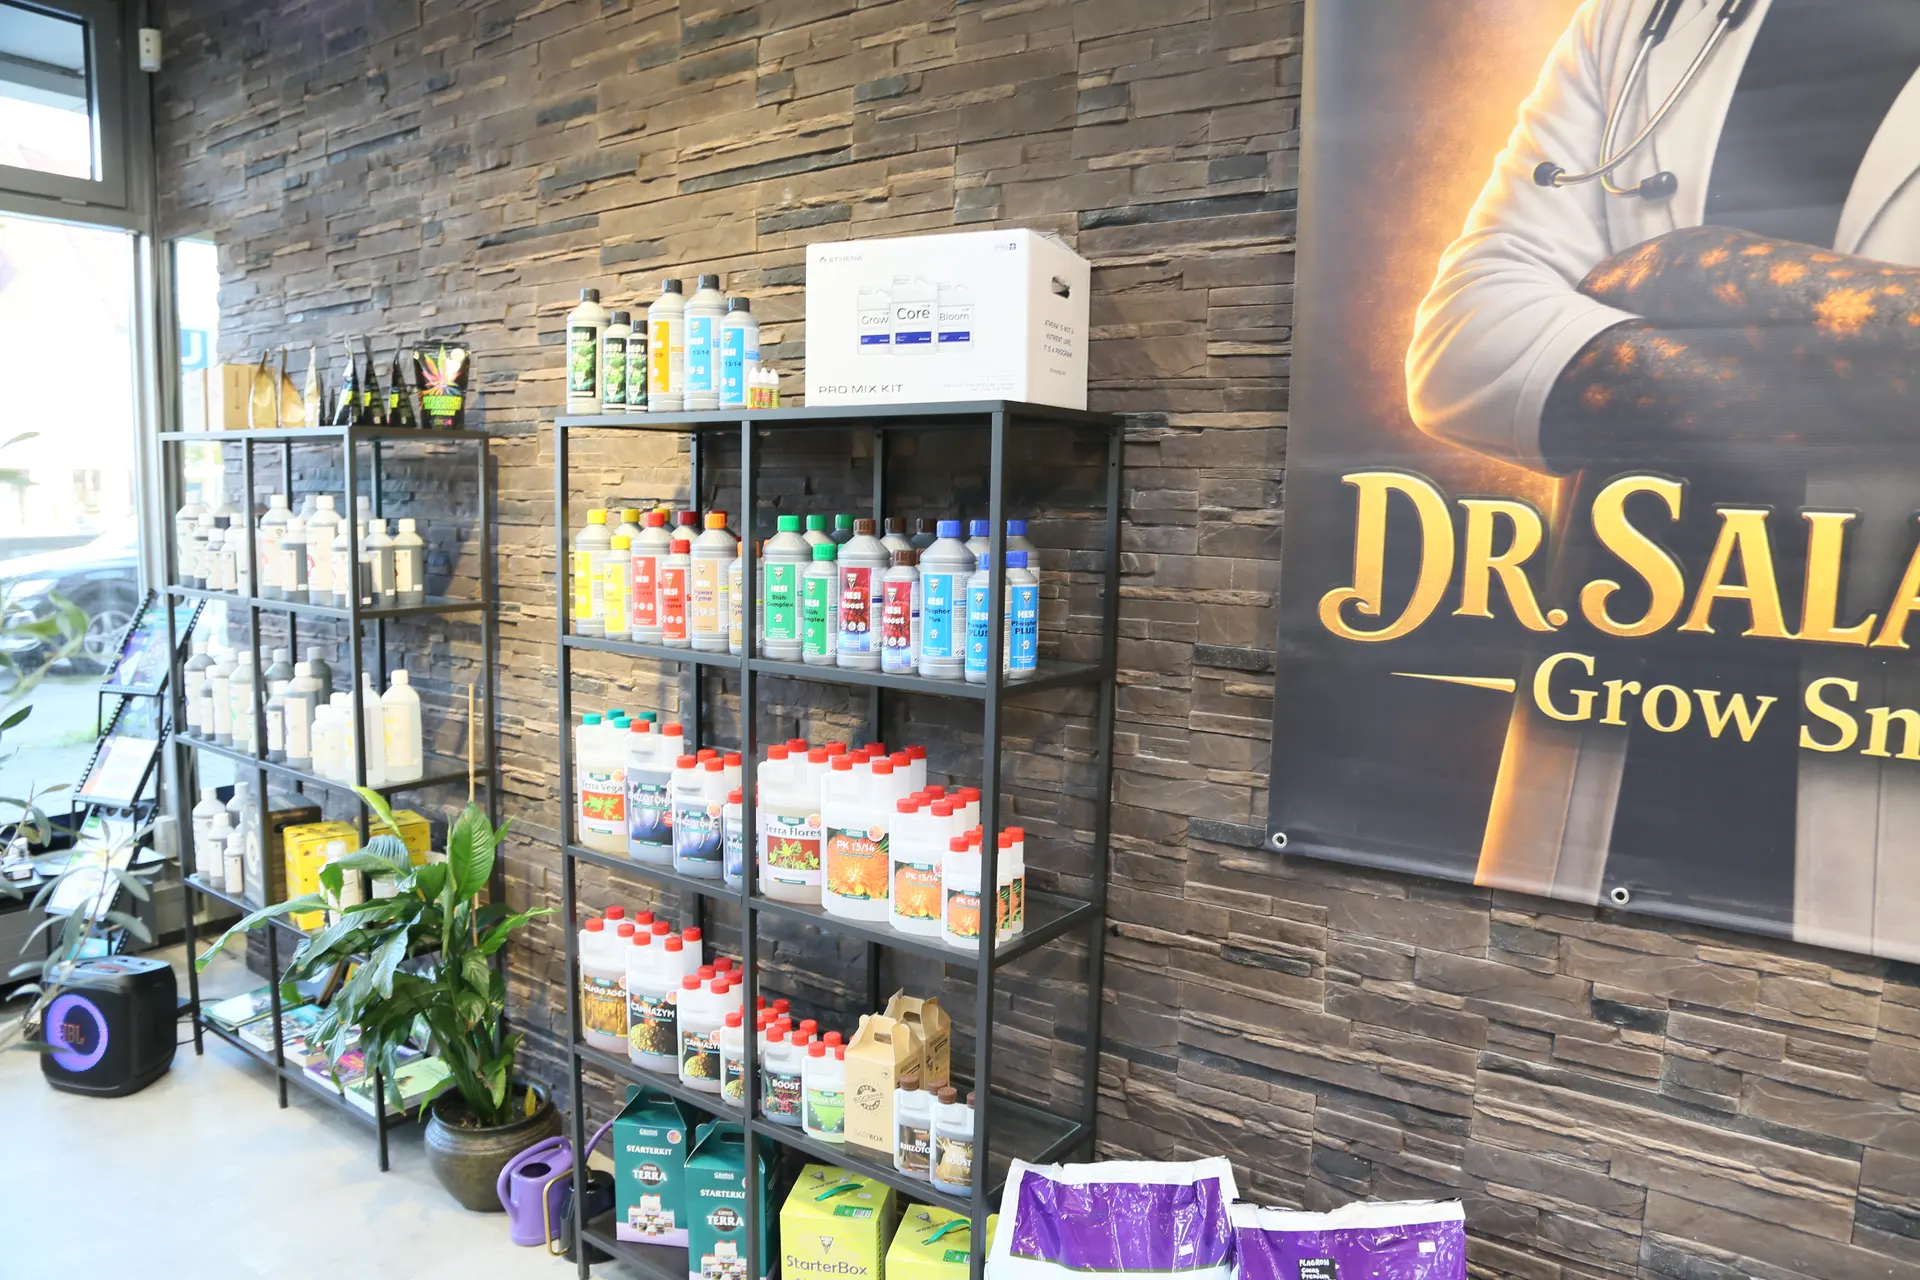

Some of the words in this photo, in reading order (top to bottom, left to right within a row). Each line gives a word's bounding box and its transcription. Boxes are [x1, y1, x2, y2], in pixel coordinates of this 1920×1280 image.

[897, 308, 930, 320] Core
[940, 313, 970, 321] Bloom
[862, 316, 889, 325] Grow
[818, 385, 847, 394] PRO
[851, 384, 877, 394] MIX
[881, 383, 903, 393] KIT
[842, 601, 864, 609] Boost
[927, 598, 944, 606] HESI
[885, 606, 902, 614] HESI
[1017, 610, 1034, 618] HESI
[1014, 627, 1035, 635] PLUS
[1533, 652, 1778, 743] Grow
[764, 823, 787, 834] Terra
[790, 826, 821, 837] Flores
[836, 839, 848, 850] PK
[851, 841, 876, 852] 13/14
[905, 872, 917, 880] PK
[918, 872, 938, 882] 13/14
[772, 1079, 801, 1091] BOOST
[626, 1144, 672, 1156] STARTERKIT
[632, 1169, 667, 1182] TERRA
[706, 1215, 745, 1227] TERRA
[786, 1255, 868, 1276] StarterBox
[1299, 1258, 1330, 1267] PLAGRON
